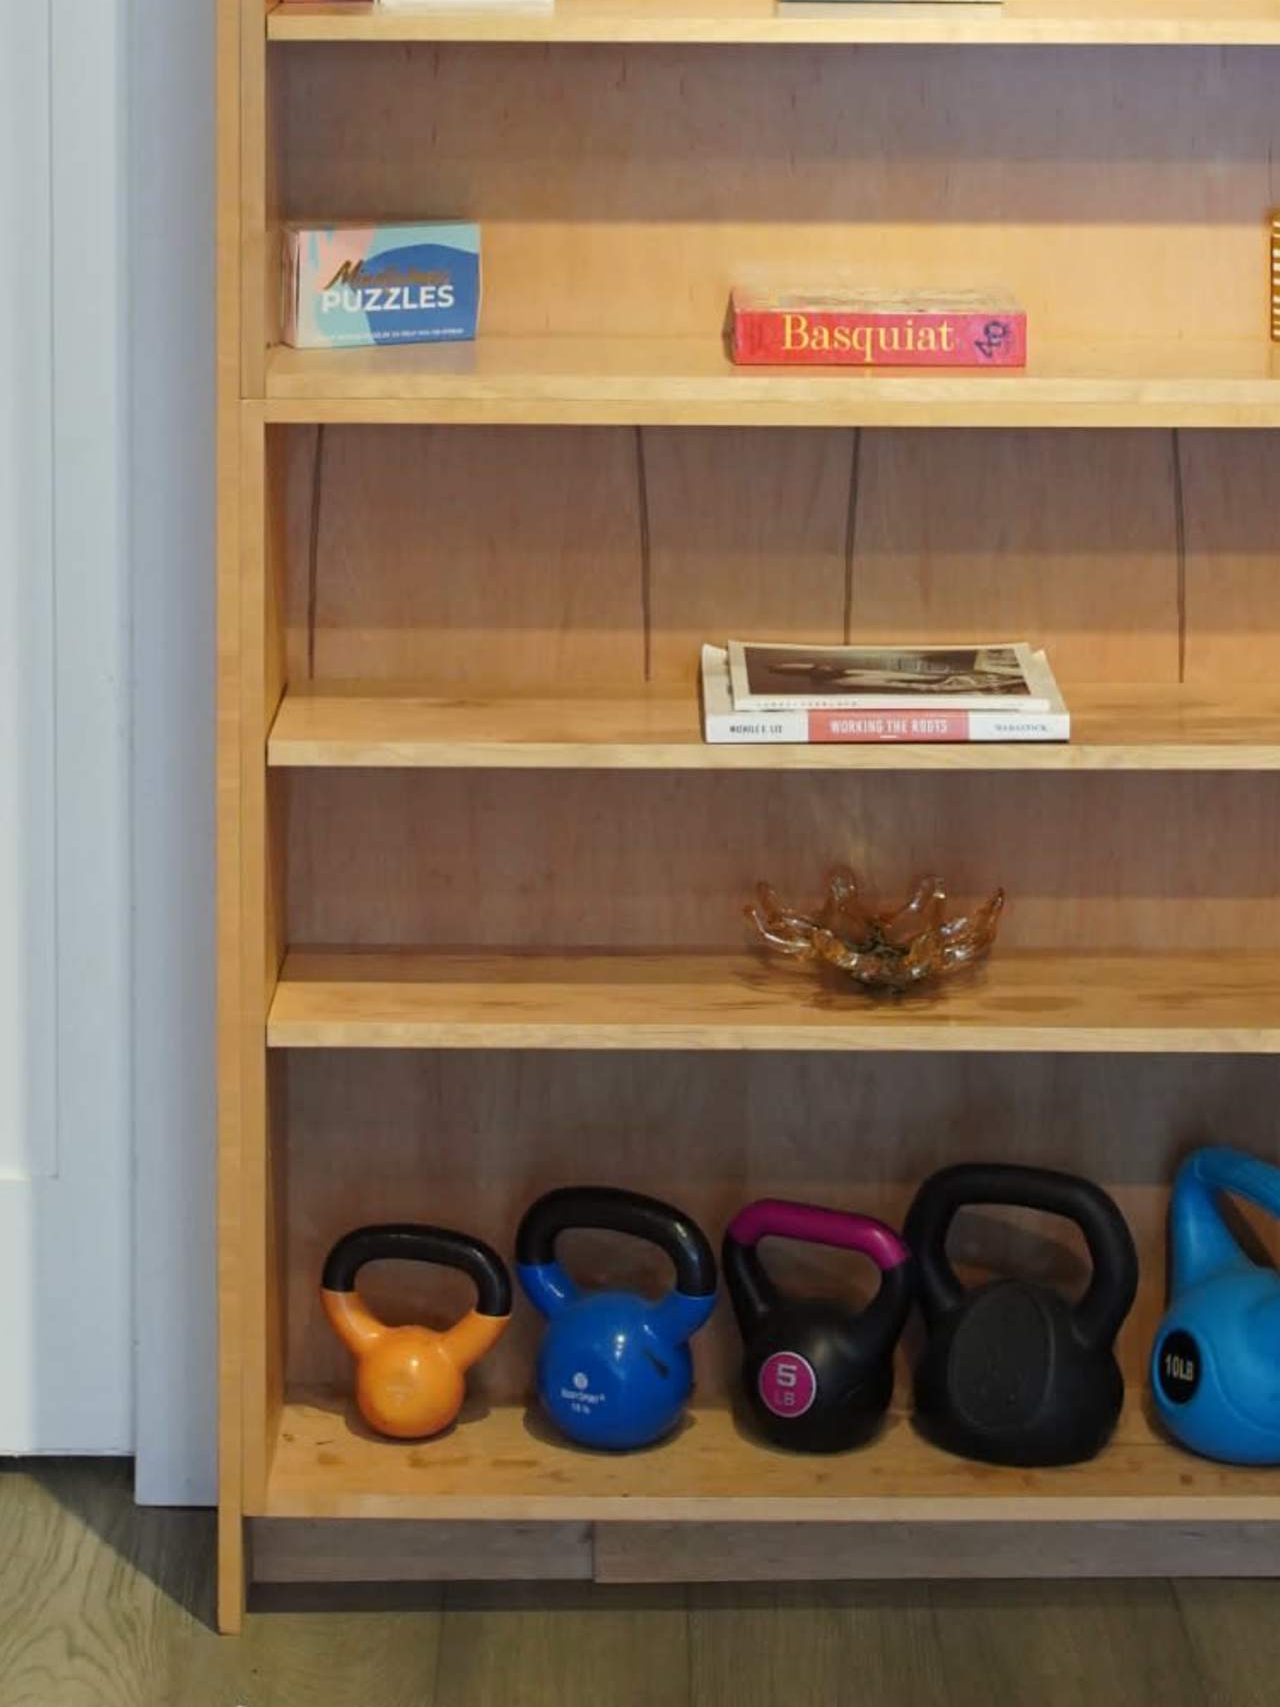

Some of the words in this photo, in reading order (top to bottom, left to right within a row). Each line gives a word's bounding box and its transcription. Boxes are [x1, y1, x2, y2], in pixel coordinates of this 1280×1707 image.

[321, 284, 455, 313] PUZZLES
[781, 313, 956, 364] Basquiat
[830, 719, 884, 734] WORKING
[886, 719, 908, 734] THE
[912, 719, 948, 734] ROOTS
[776, 1363, 797, 1387] 5
